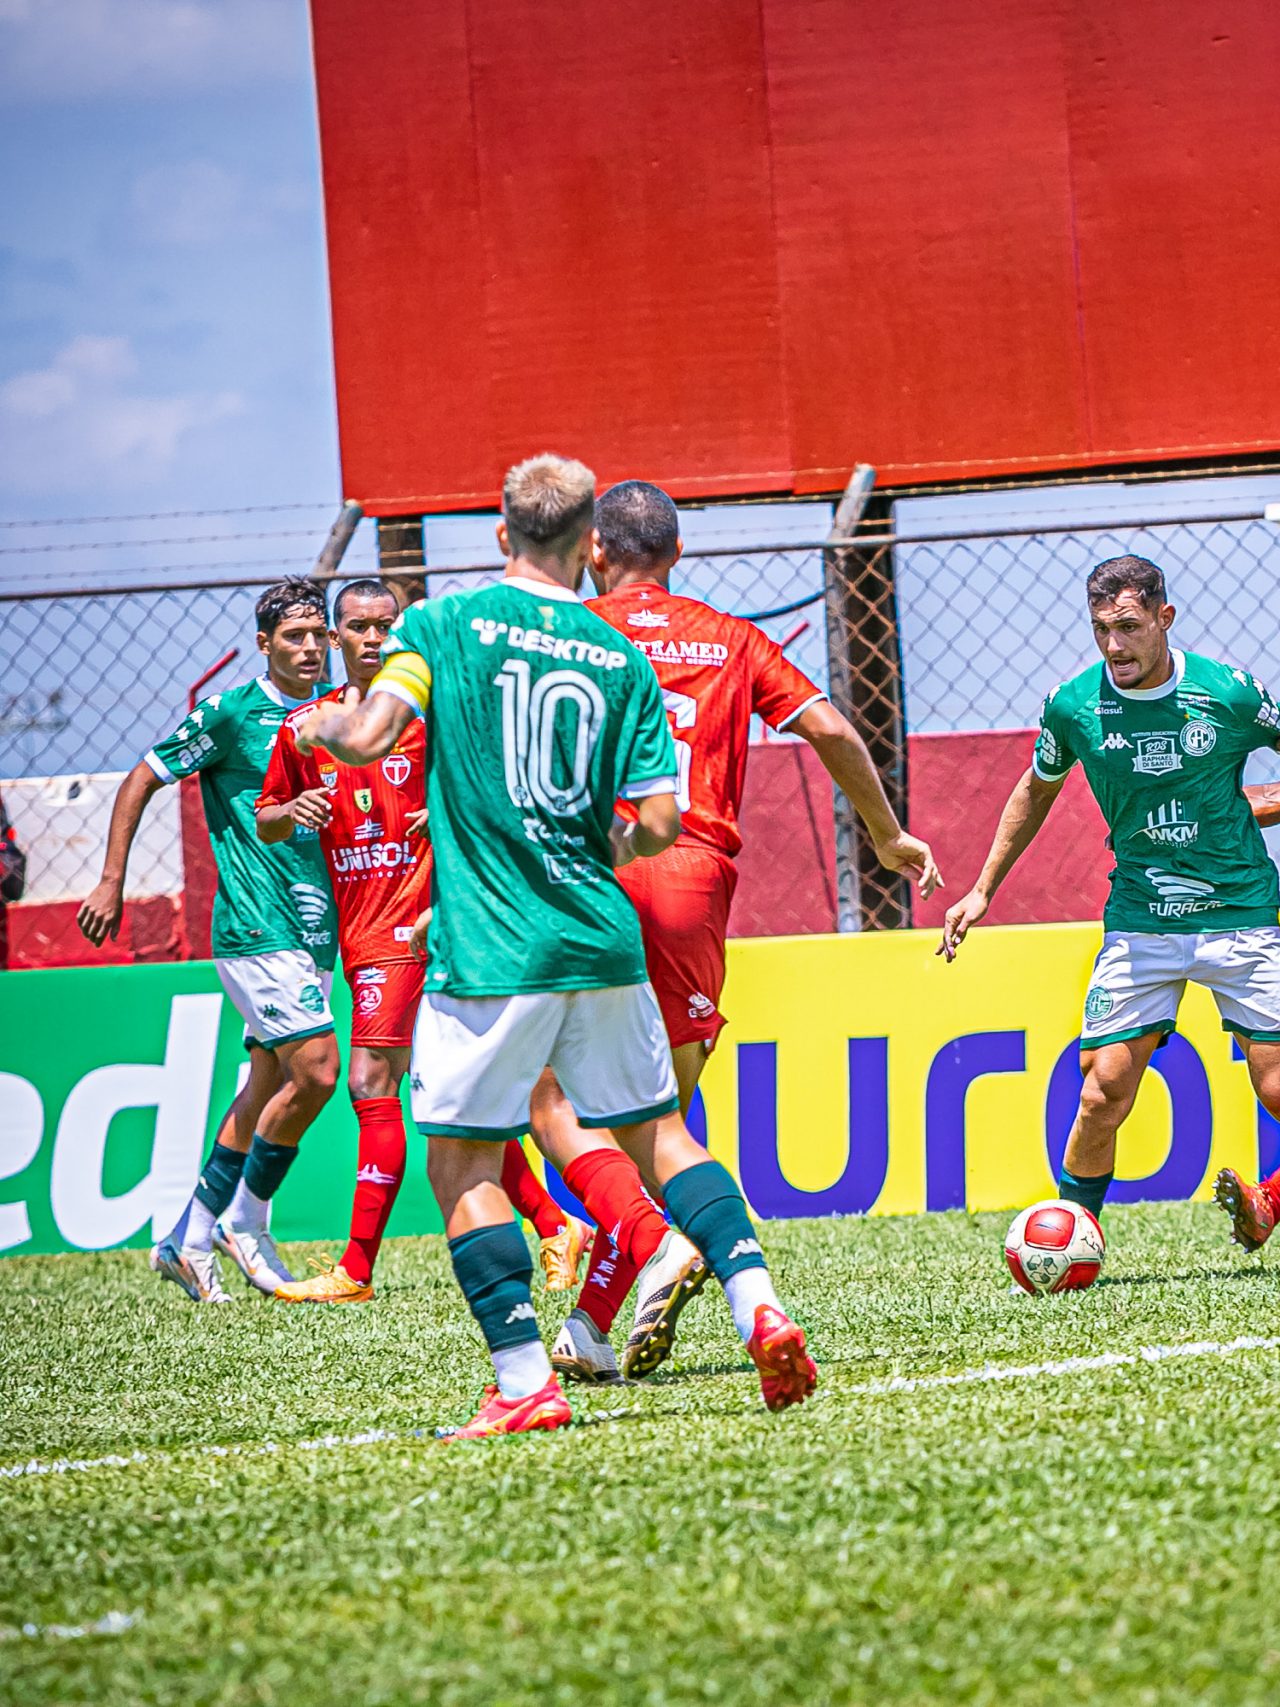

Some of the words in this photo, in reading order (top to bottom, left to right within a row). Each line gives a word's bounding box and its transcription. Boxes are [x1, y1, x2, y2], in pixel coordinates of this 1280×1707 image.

[507, 626, 628, 671] DESKTOP
[633, 640, 728, 661] TRAMED
[493, 658, 607, 817] 10
[1144, 740, 1168, 753] RDS
[1142, 754, 1174, 762] RAPHAEL
[1150, 760, 1174, 768] SANTO
[1144, 822, 1199, 842] WKM
